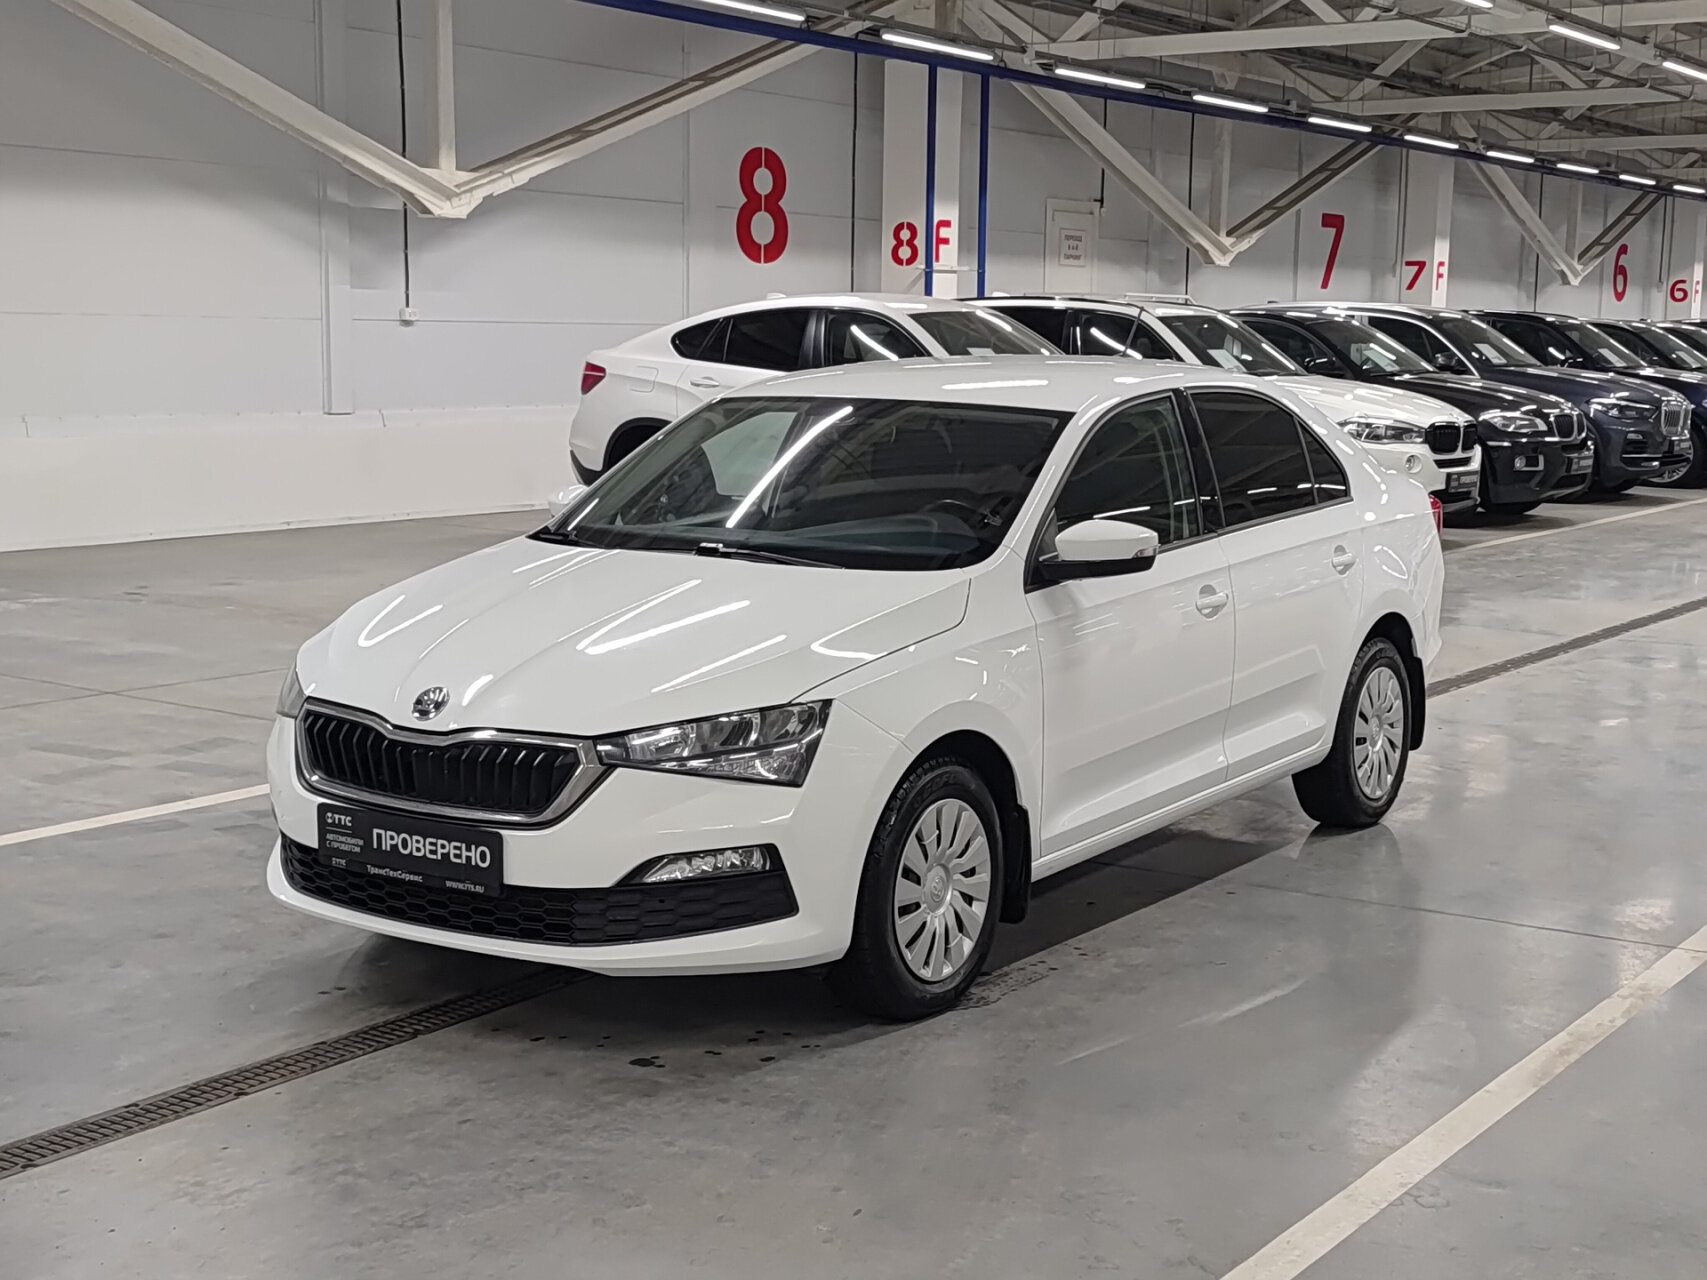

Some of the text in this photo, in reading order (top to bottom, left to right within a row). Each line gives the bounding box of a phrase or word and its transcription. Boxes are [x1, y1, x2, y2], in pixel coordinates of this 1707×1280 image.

[735, 146, 789, 264] 8
[891, 219, 952, 267] 8 F
[1320, 212, 1345, 290] 7
[1404, 260, 1446, 291] 7 F
[1612, 243, 1629, 302] 6
[1670, 279, 1689, 303] 6
[372, 828, 491, 868] ПРОВЕРЕНО
